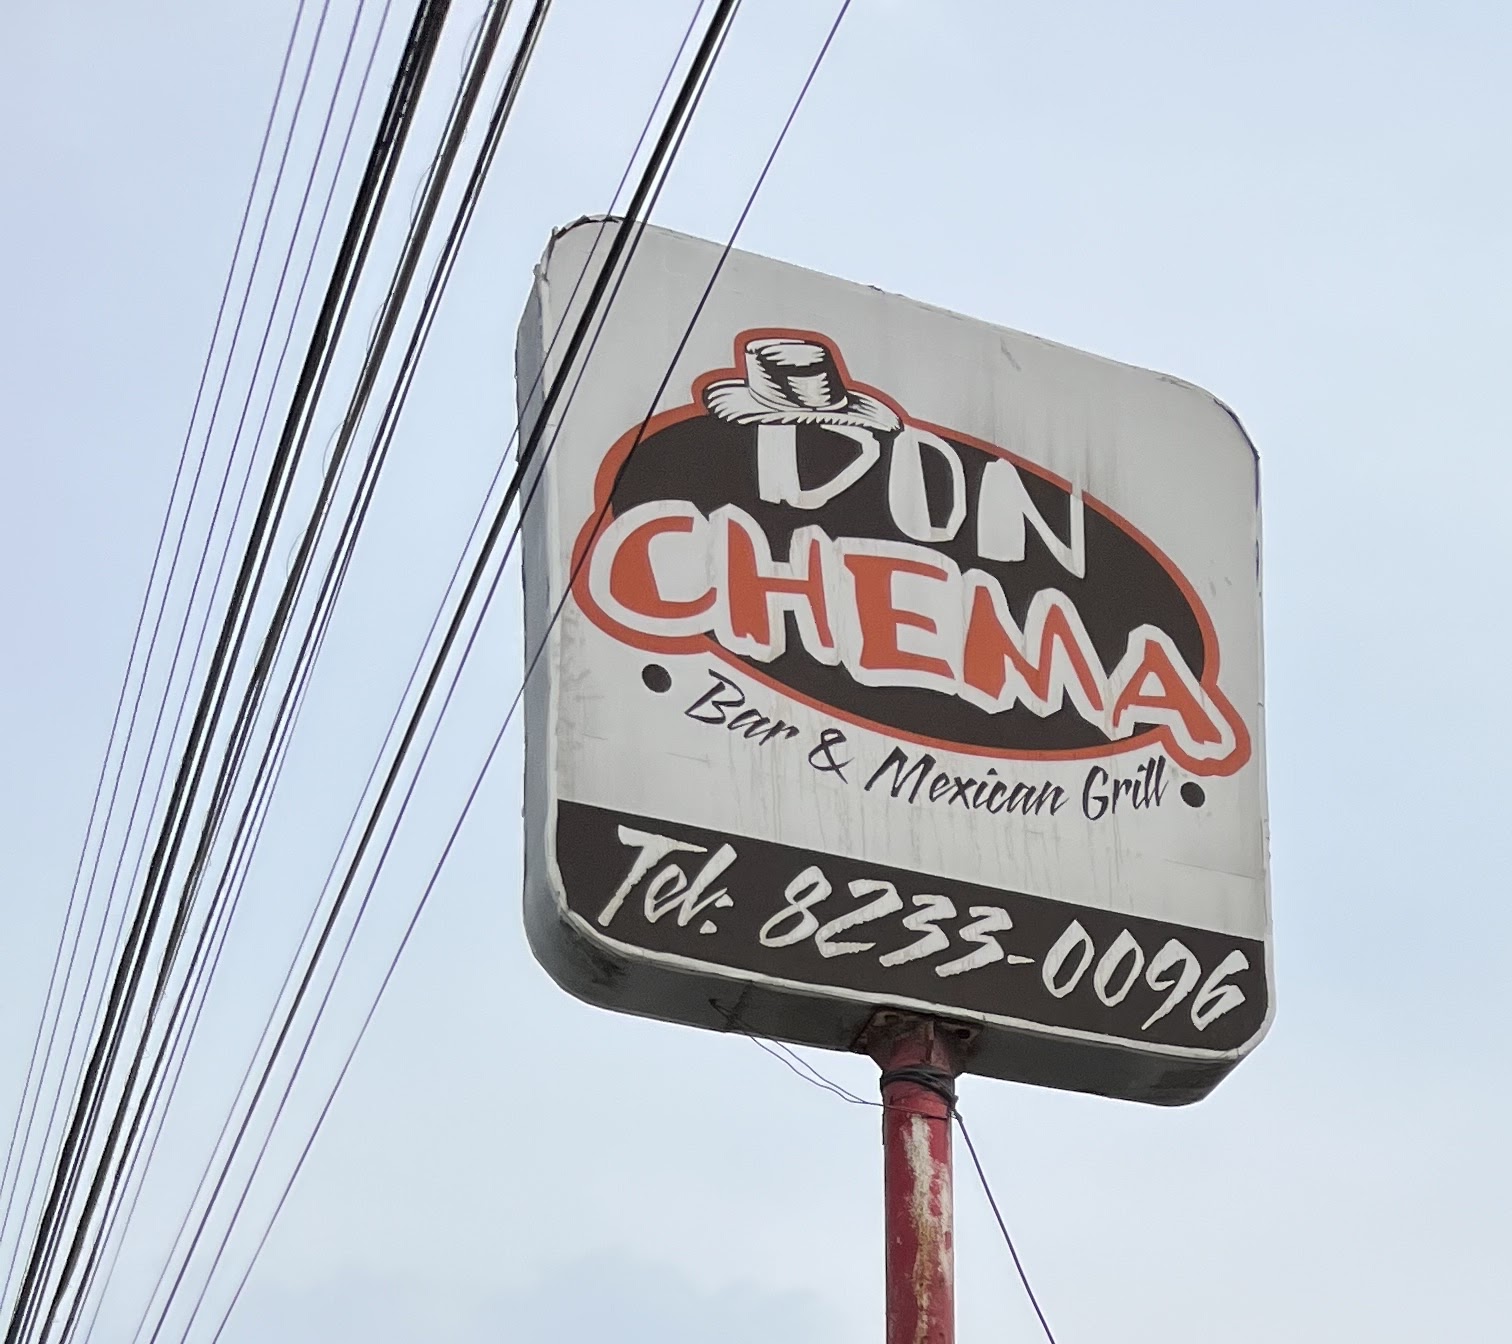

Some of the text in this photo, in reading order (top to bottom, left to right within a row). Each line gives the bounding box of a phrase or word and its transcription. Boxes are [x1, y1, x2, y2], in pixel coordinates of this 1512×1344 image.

[757, 424, 1085, 578] DON
[602, 505, 1232, 759] CHEMA
[683, 669, 1170, 820] Bar & Mexican Grill
[757, 866, 1251, 1032] 8233-0096
